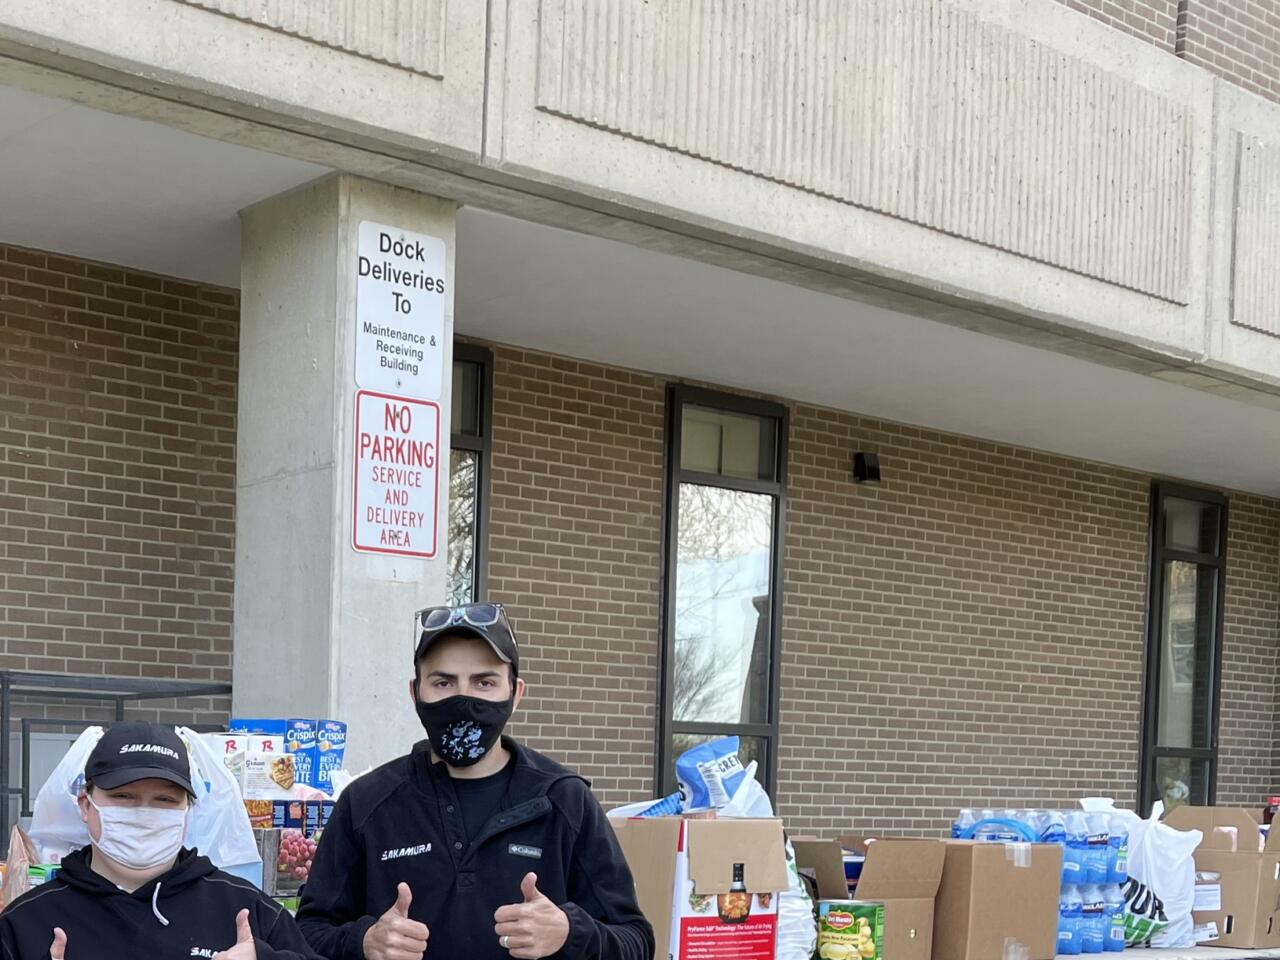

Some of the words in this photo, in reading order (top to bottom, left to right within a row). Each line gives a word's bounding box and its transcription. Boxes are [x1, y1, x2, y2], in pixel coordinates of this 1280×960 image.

[379, 232, 425, 262] Dock
[358, 256, 445, 294] Deliveries
[391, 291, 412, 314] To
[363, 321, 426, 345] Maintenance
[429, 335, 437, 347] &
[376, 340, 424, 361] Receiving
[380, 356, 419, 376] Building
[384, 402, 412, 434] NO
[360, 432, 434, 468] PARKING
[372, 465, 422, 488] SERVICE
[385, 488, 409, 506] AND
[367, 506, 425, 529] DELIVERY
[380, 529, 411, 547] AREA
[287, 728, 316, 741] Crispix
[318, 729, 345, 742] Crispix
[119, 743, 180, 760] SAKAMURA
[381, 843, 432, 861] SAKAMURA
